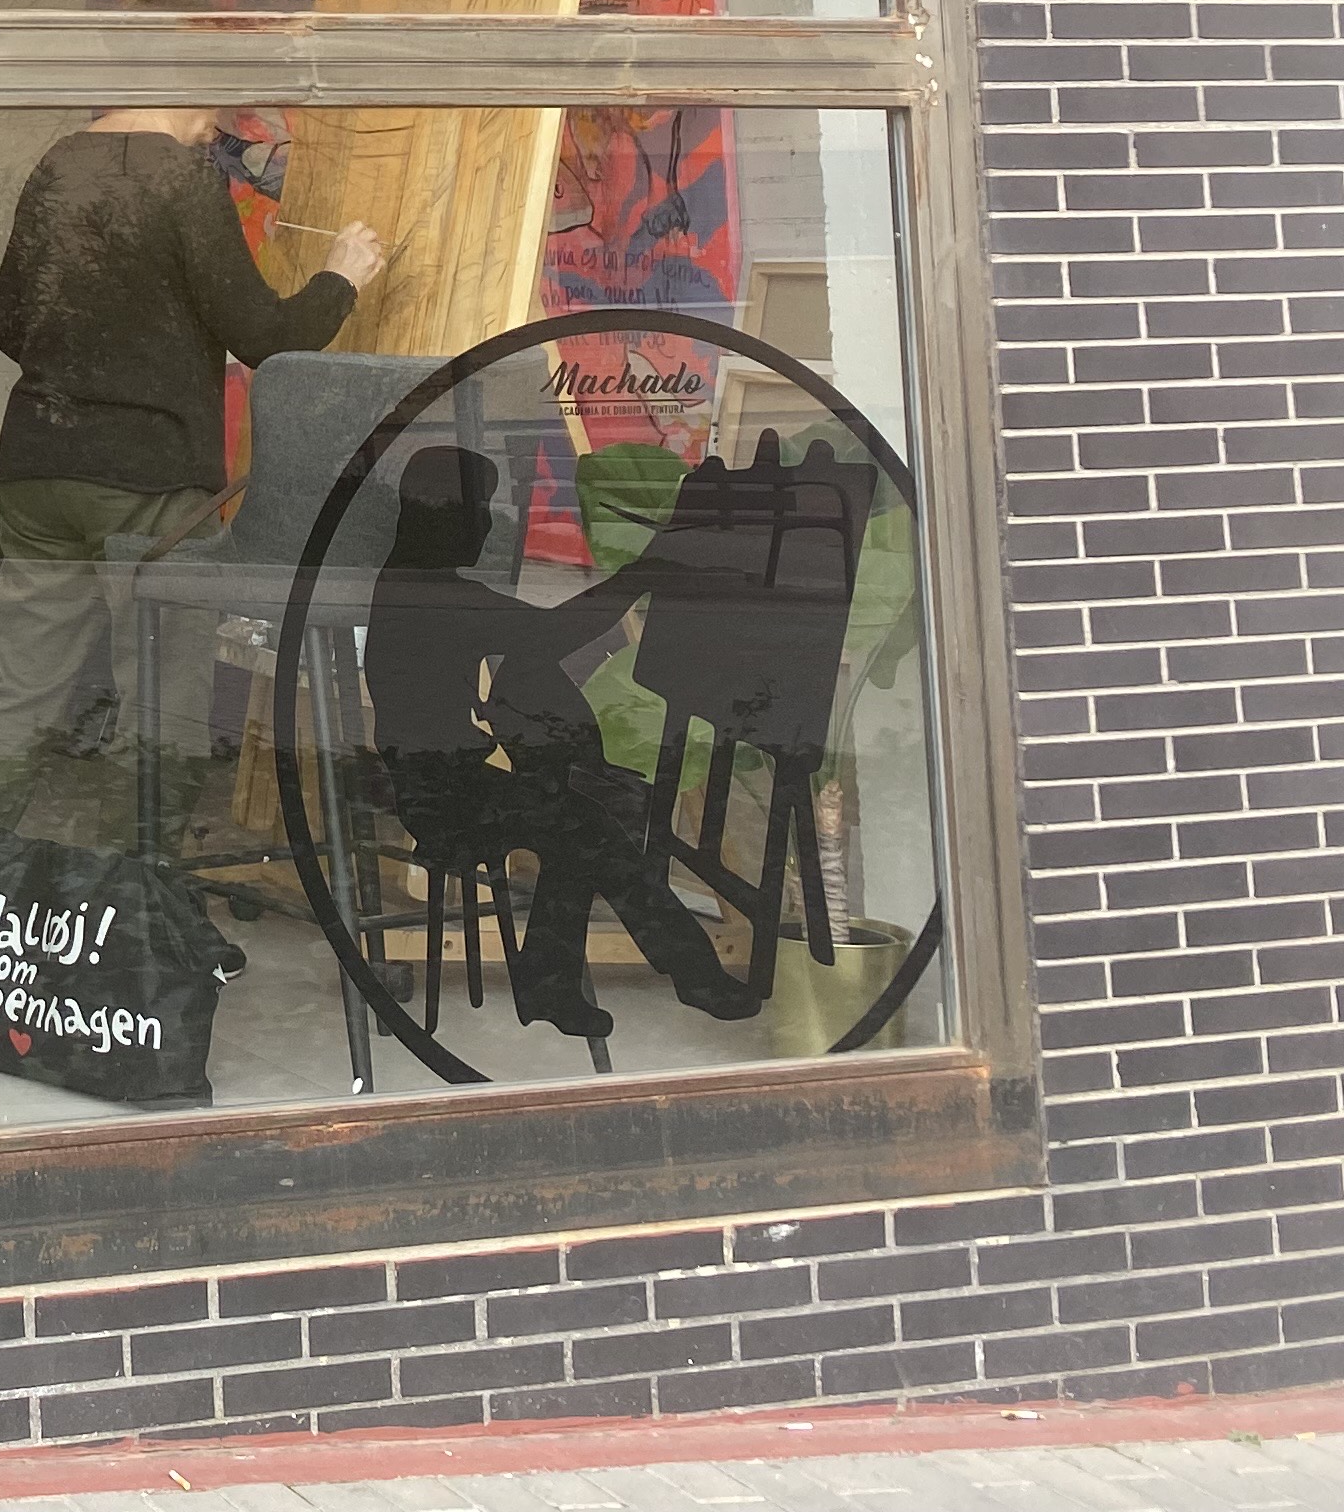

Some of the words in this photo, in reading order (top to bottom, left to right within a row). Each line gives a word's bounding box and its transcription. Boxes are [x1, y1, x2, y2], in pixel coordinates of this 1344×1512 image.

[539, 359, 706, 397] Machado
[559, 405, 600, 417] ACADEMIA
[601, 405, 612, 416] DE
[613, 404, 642, 416] DIBUJO
[650, 404, 686, 415] PINTURA
